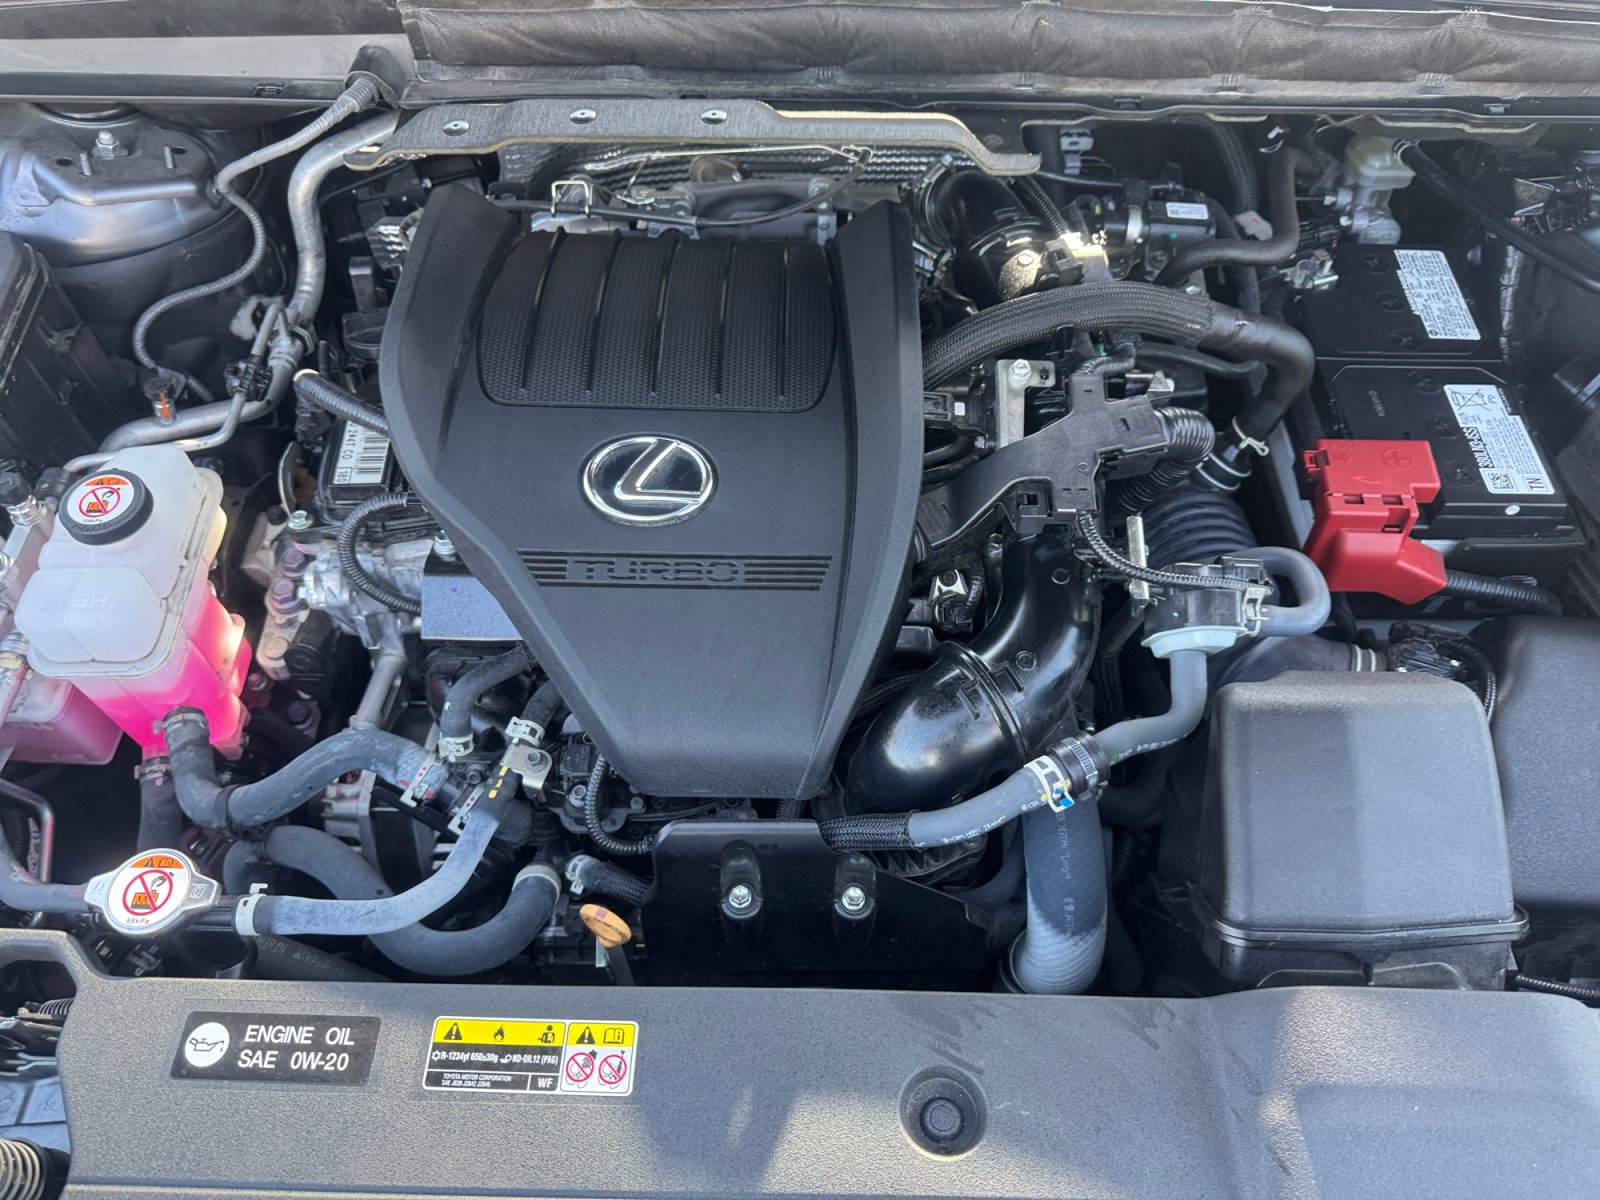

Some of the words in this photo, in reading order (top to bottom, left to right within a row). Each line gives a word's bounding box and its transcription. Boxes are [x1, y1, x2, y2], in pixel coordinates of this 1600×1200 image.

[1525, 477, 1545, 490] TN
[572, 558, 740, 583] TURBO
[244, 1024, 315, 1044] ENGINE
[325, 1026, 355, 1046] OIL
[237, 1049, 278, 1069] SAE
[290, 1052, 349, 1071] 0W-20
[440, 1050, 470, 1062] R-1234yf
[541, 1055, 558, 1066] (PAG)
[443, 1072, 460, 1080] TOYOTA
[479, 1074, 512, 1082] CORPORATION
[538, 1077, 553, 1088] WF
